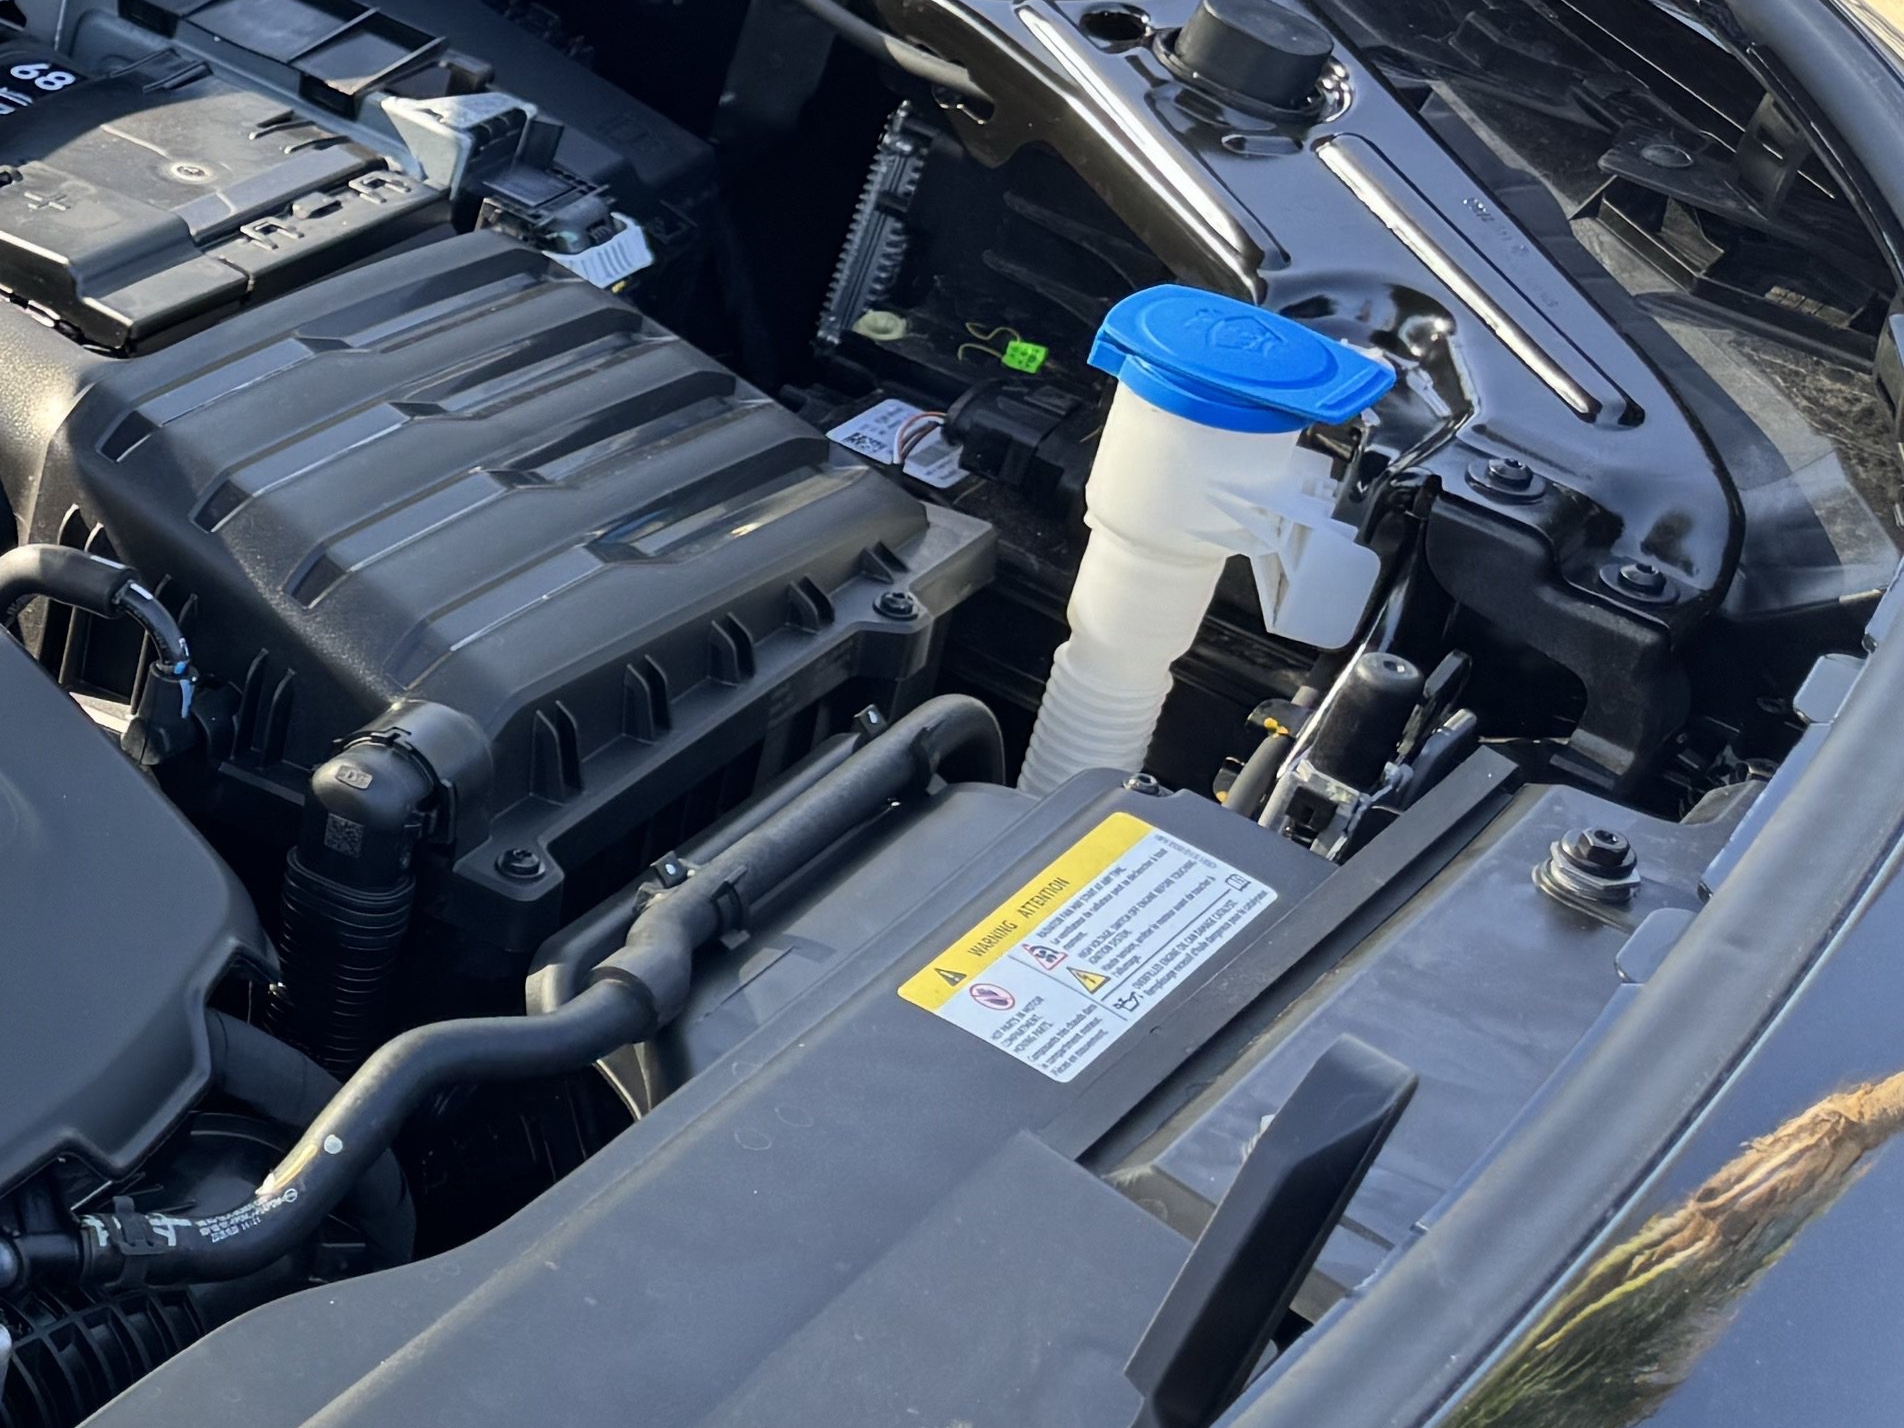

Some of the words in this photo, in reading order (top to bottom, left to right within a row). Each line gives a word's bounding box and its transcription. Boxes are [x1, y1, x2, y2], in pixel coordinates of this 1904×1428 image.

[10, 63, 77, 93] 68
[967, 919, 1017, 956] WARNING
[1017, 876, 1069, 918] ATTENTION
